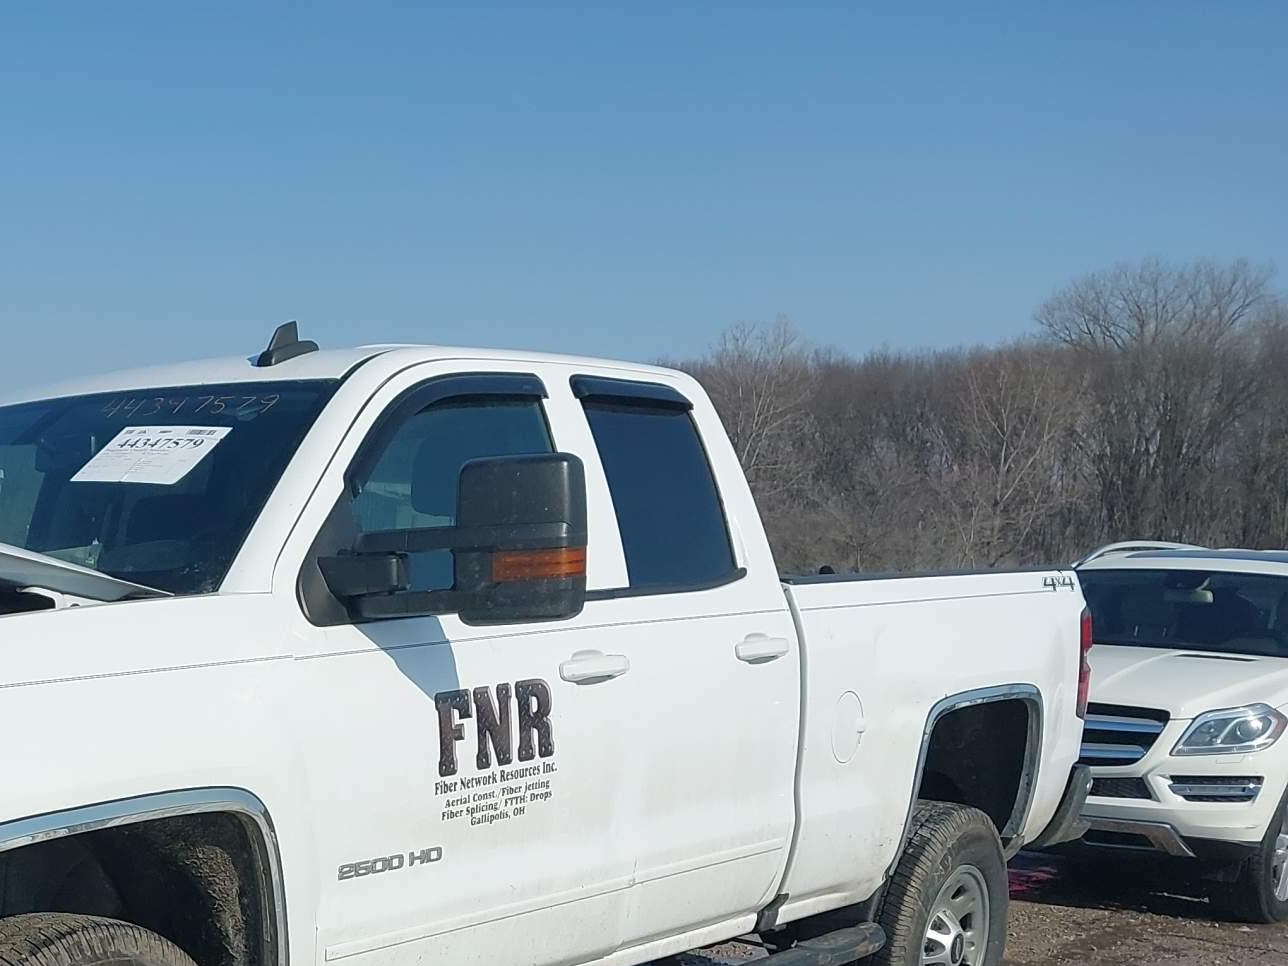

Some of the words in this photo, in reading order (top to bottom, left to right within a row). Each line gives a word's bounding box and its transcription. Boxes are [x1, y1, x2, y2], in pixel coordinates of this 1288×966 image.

[103, 394, 280, 419] 44347579
[117, 437, 205, 449] 44347579
[434, 678, 555, 777] FNR
[435, 780, 458, 795] Fiber
[460, 772, 497, 790] Network
[500, 765, 541, 782] Resources
[543, 762, 558, 774] Inc.
[441, 808, 467, 821] Fiber
[530, 790, 553, 802] Drops
[445, 795, 470, 808] Aerial
[471, 810, 510, 825] Gallipolis,
[513, 806, 526, 816] OH
[338, 854, 404, 880] 2500
[409, 846, 443, 867] HD
